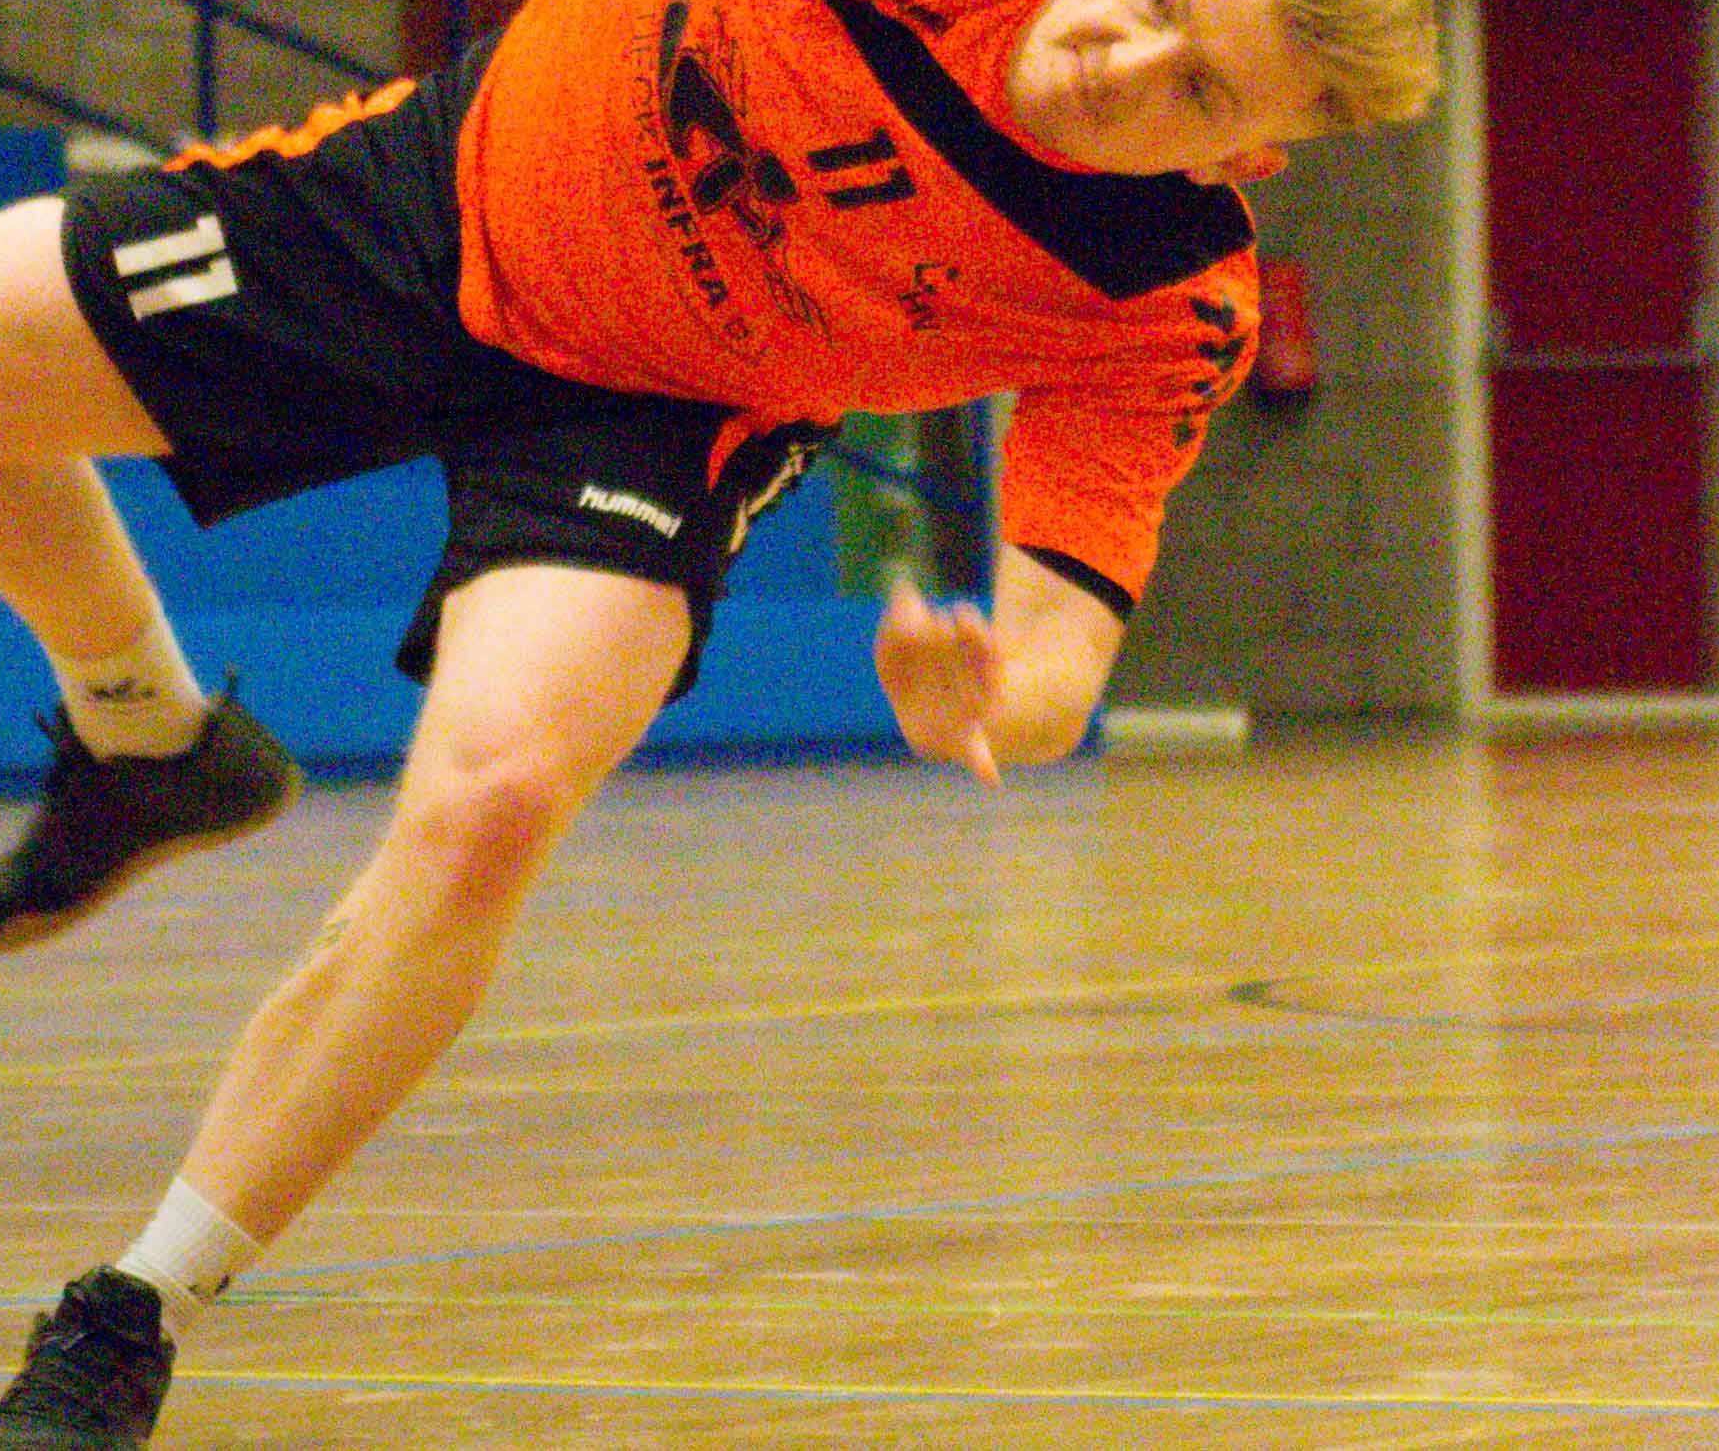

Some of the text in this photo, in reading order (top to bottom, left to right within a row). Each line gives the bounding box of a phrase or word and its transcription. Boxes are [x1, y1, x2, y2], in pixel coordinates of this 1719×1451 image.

[806, 126, 918, 212] 11
[113, 214, 238, 322] 11
[644, 157, 730, 312] INFRA
[578, 484, 683, 539] hummel
